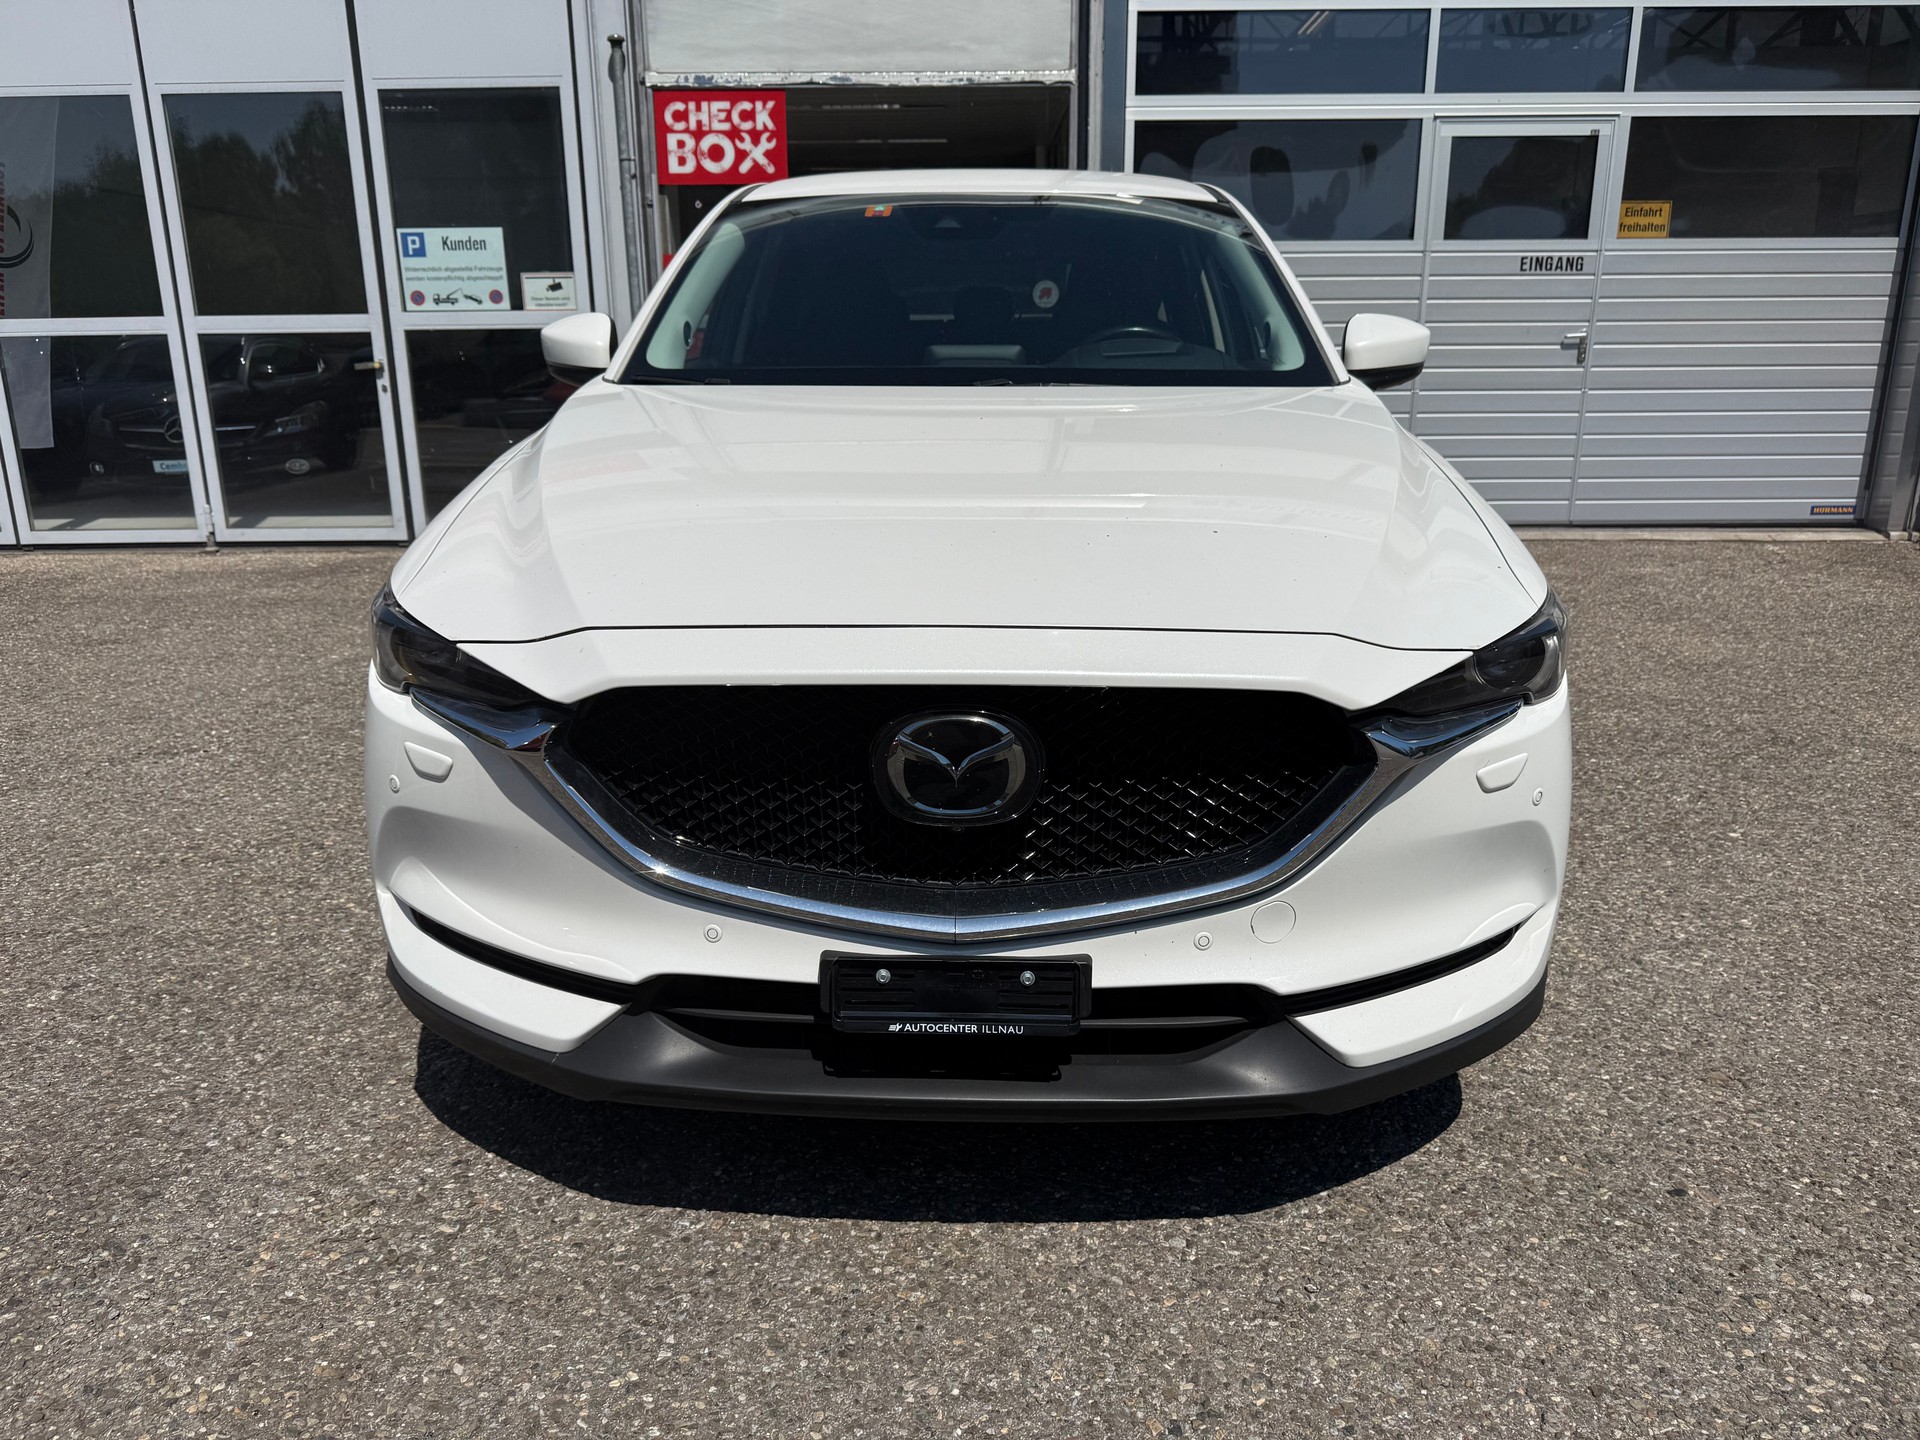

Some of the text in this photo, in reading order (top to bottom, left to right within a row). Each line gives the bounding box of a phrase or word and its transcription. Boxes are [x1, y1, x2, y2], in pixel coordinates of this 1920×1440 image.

[664, 101, 776, 131] CHECK
[666, 132, 777, 174] BOX
[1625, 207, 1663, 218] Einfahrt
[1619, 222, 1666, 233] freihalten
[407, 236, 487, 255] P Kunden
[1520, 256, 1584, 272] EINGANG
[904, 1023, 1024, 1035] AUTOCENTER ILLNAU
